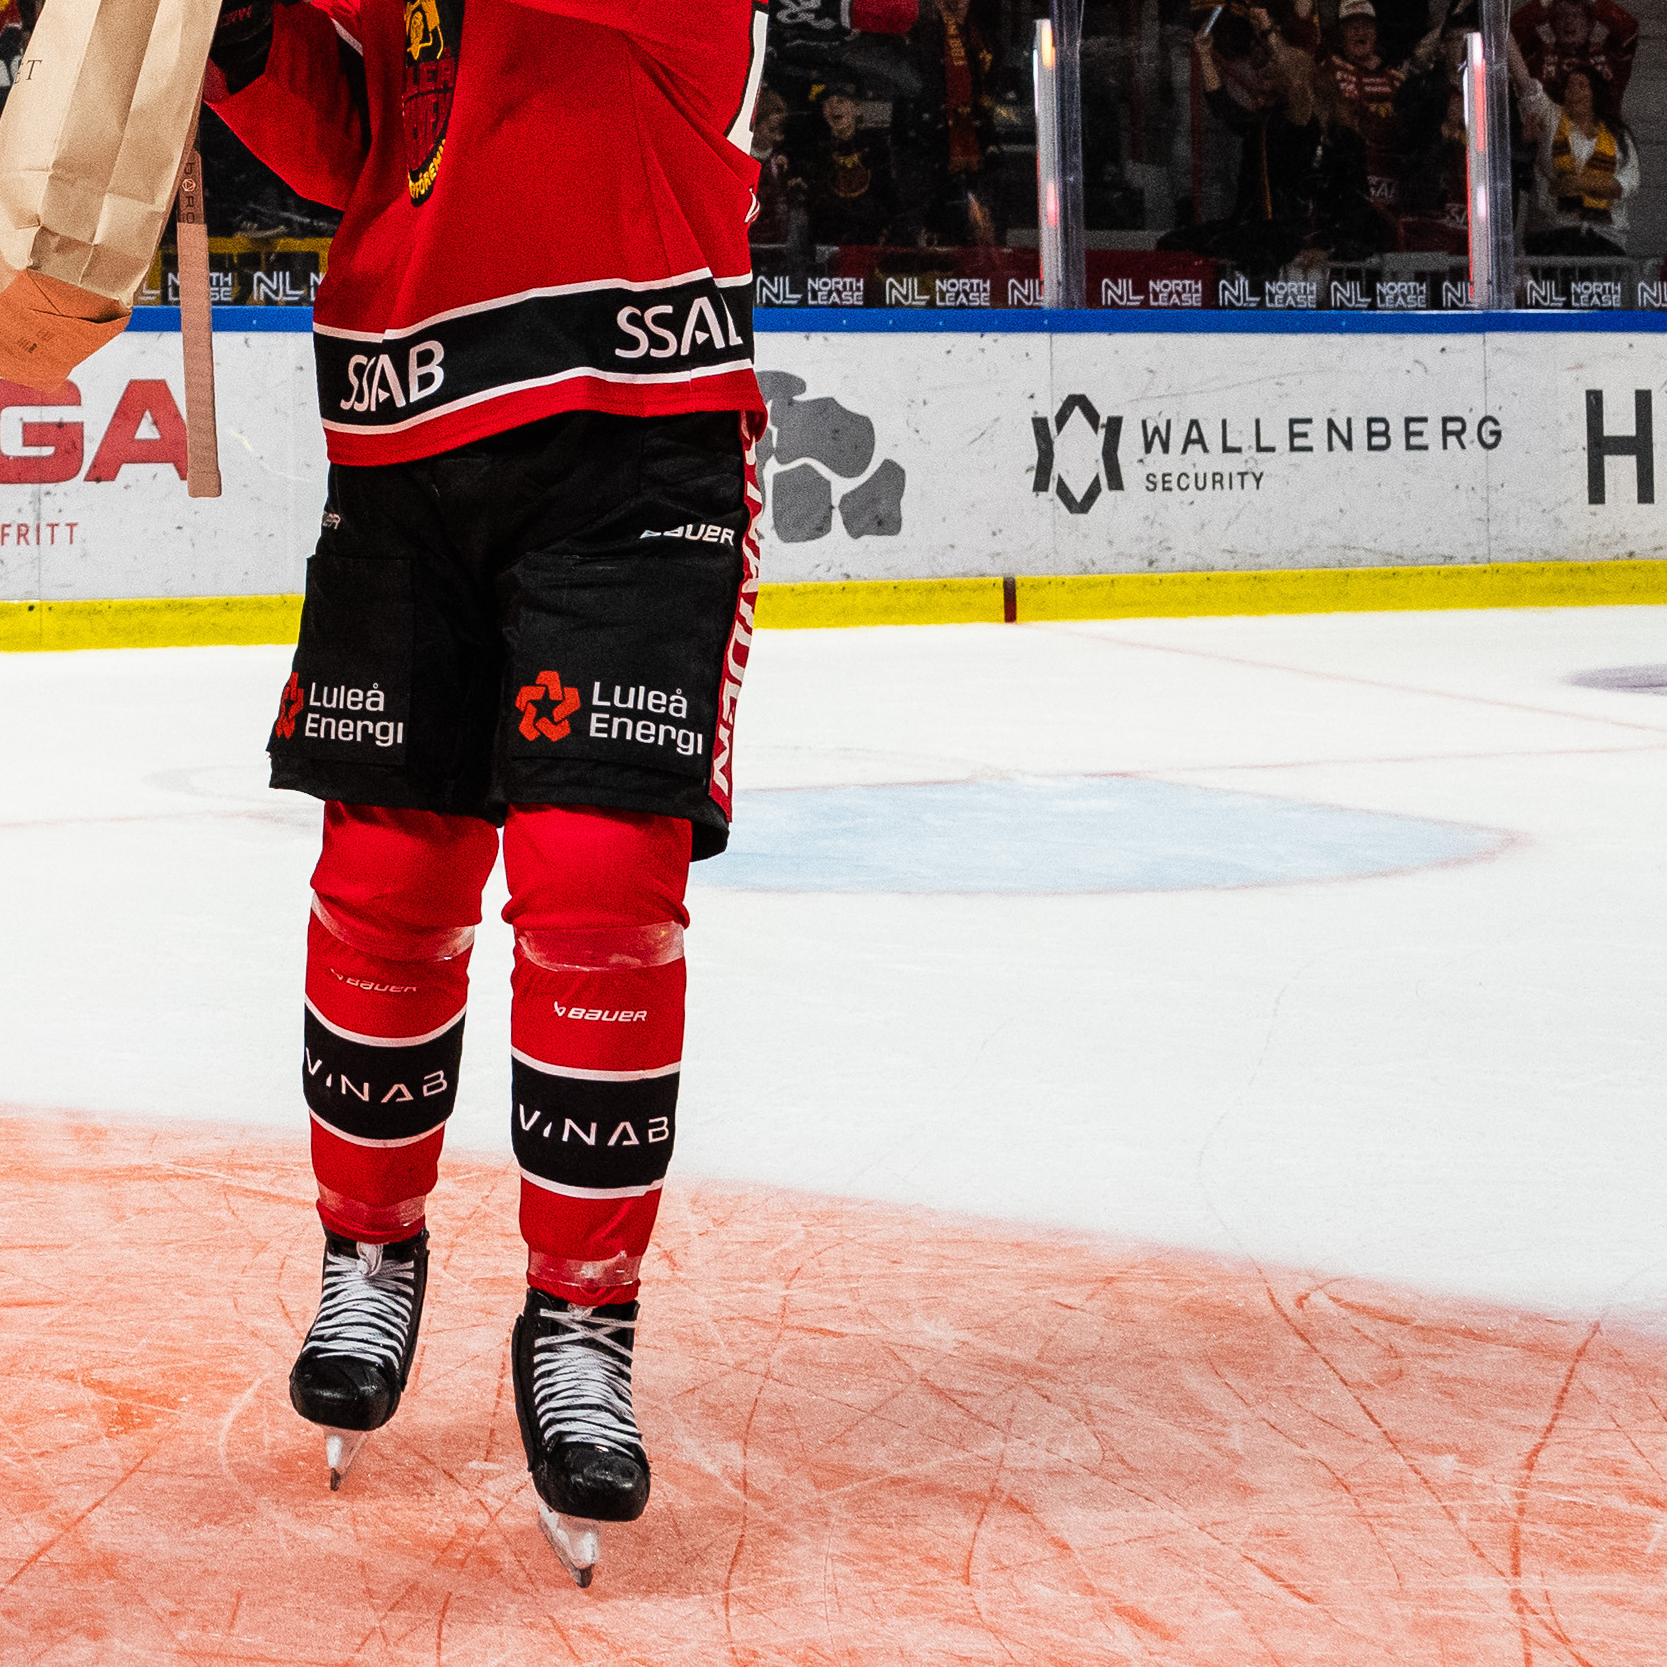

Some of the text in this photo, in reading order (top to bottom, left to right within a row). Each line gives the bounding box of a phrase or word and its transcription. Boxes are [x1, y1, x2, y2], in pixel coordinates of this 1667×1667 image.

[169, 271, 232, 286] NTH
[808, 277, 864, 291] NORTH
[936, 278, 990, 292] NORTH
[1150, 280, 1202, 293] NORTH
[1266, 281, 1317, 294] NORTH
[1376, 281, 1427, 294] NORTH
[1572, 281, 1620, 294] NORTH
[808, 291, 864, 305] LEASE
[936, 292, 990, 306] LEASE
[1150, 293, 1202, 307] LEASE
[1266, 294, 1317, 307] LEASE
[1376, 295, 1427, 308] LEASE
[1572, 295, 1620, 307] LEASE
[340, 340, 445, 413] SSAB
[1142, 415, 1504, 455] WALLENBERG
[1145, 472, 1265, 492] SECURITY
[309, 680, 386, 712] Luleå
[592, 680, 689, 719] Luleå
[305, 711, 405, 748] Energi
[588, 711, 704, 756] Energi
[566, 1005, 648, 1024] BAUER
[305, 1045, 448, 1104] VINAB
[518, 1103, 670, 1148] VINAB
